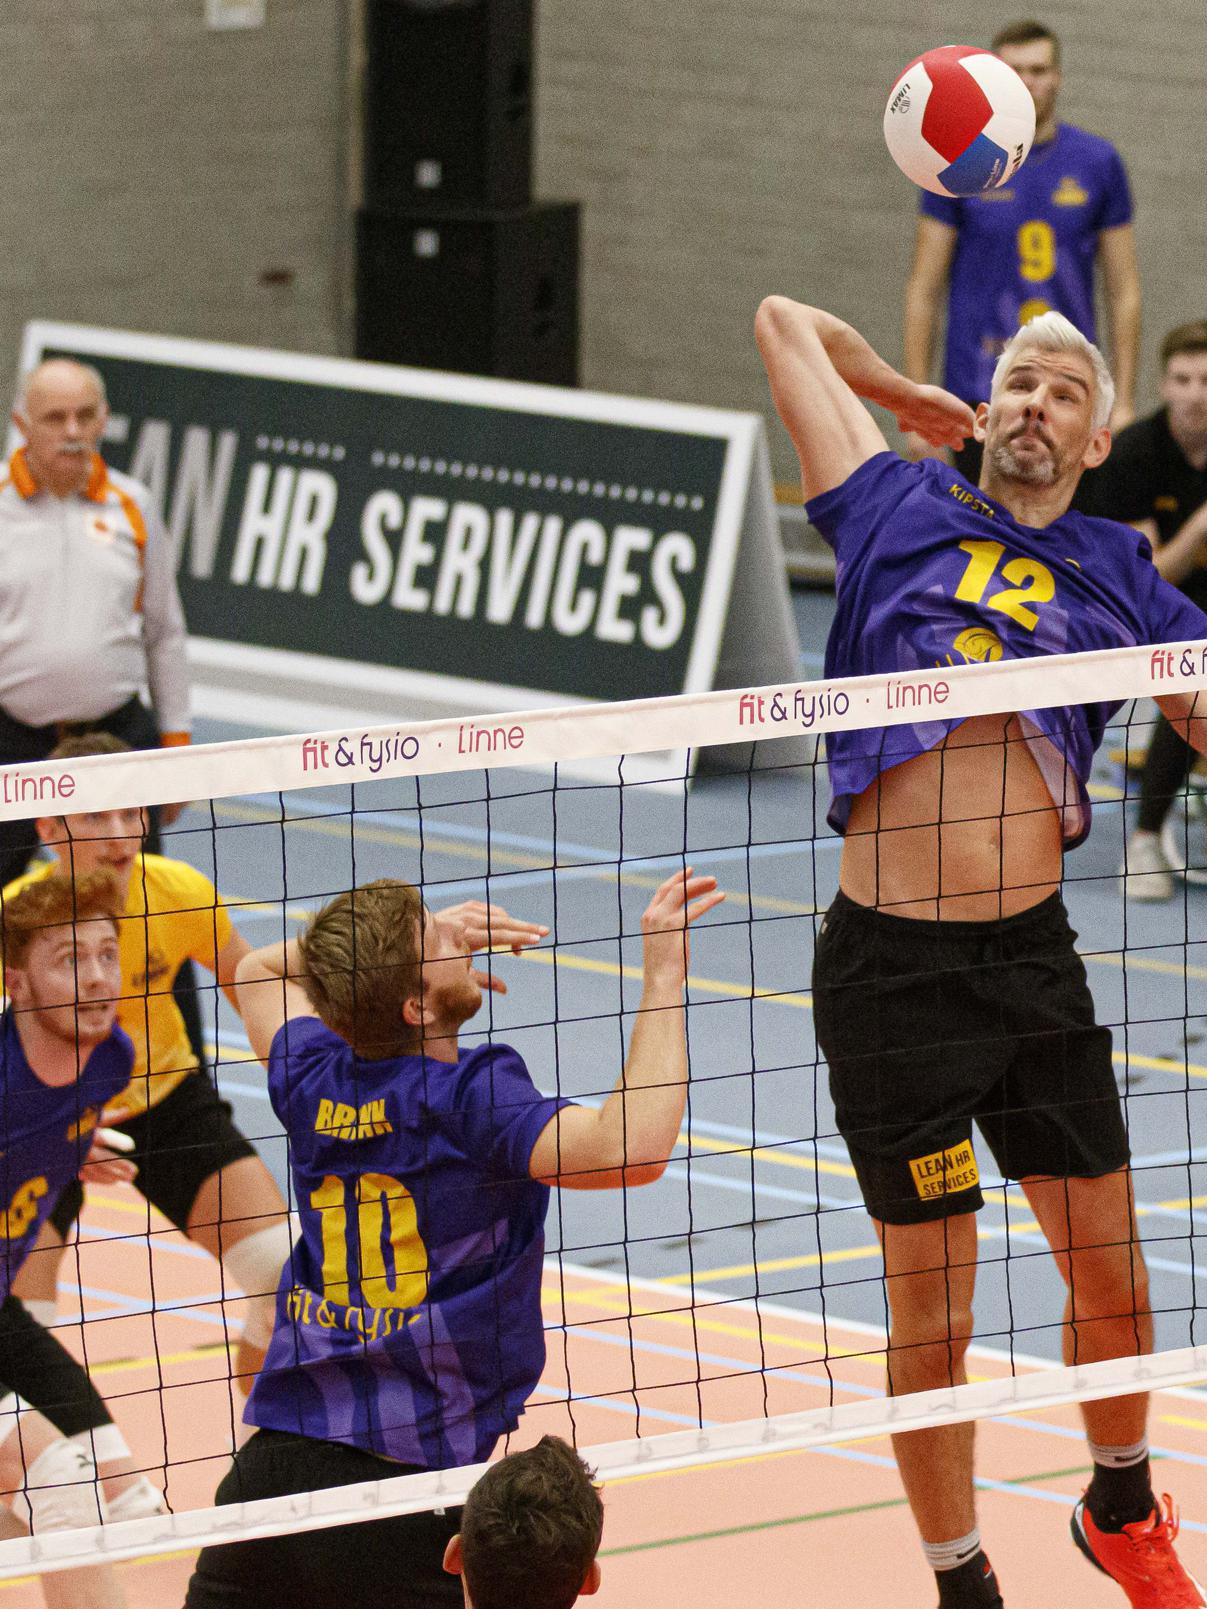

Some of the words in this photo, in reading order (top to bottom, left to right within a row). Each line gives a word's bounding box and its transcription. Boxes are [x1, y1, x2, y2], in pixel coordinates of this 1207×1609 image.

[1017, 220, 1056, 281] 9
[949, 484, 996, 519] KIPSTA
[230, 462, 338, 596] HR
[350, 489, 697, 650] SERVICES
[954, 540, 1056, 632] 12
[916, 1153, 954, 1178] LEAN
[955, 1150, 970, 1168] HR
[923, 1168, 977, 1195] SERVICES
[310, 1172, 430, 1310] 10
